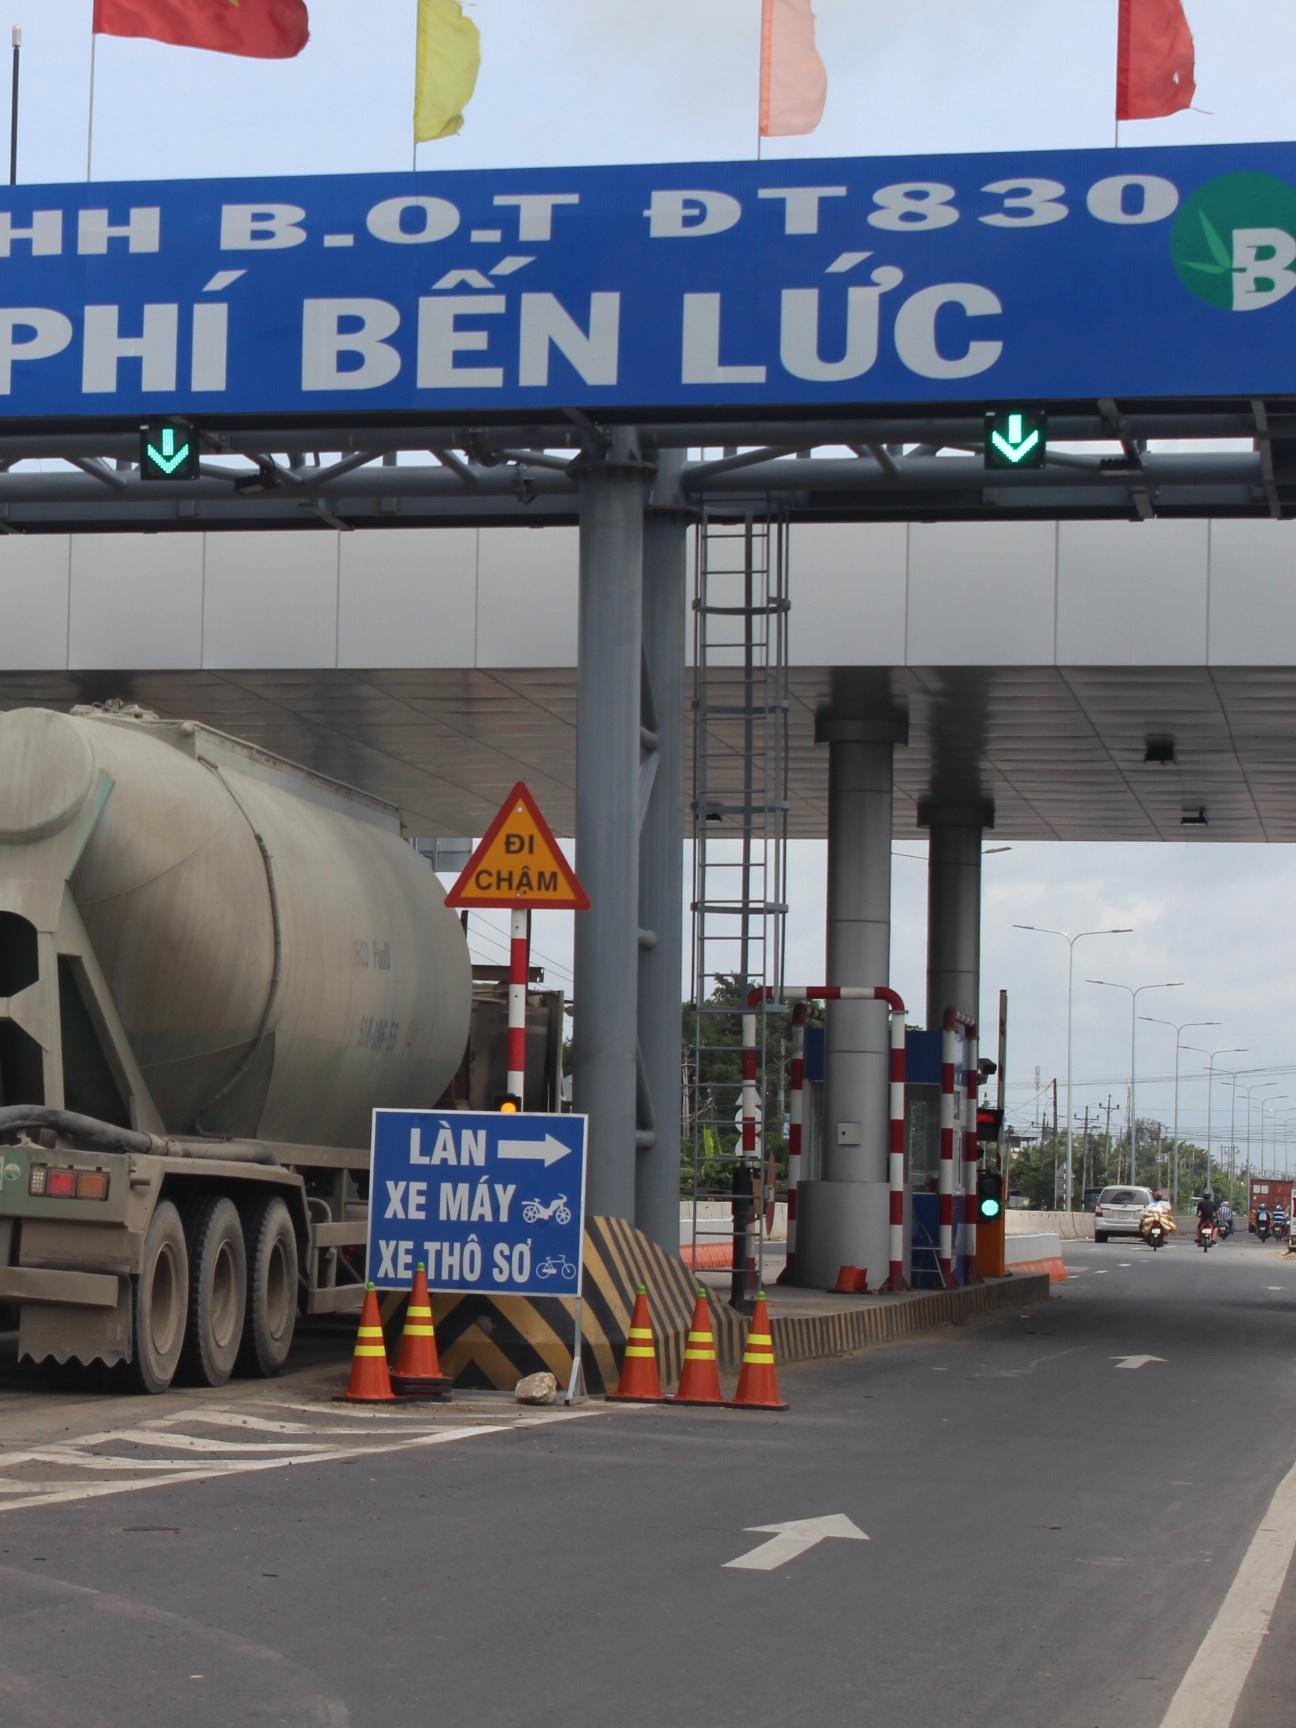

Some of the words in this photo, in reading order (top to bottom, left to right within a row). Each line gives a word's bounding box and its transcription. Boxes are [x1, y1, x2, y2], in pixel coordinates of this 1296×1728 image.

[221, 194, 579, 249] B.O.T
[644, 175, 1178, 237] ĐT830
[302, 257, 619, 390] BẾN
[683, 252, 1002, 383] LỨC
[504, 834, 534, 855] ĐI
[474, 866, 558, 895] CHẬM
[410, 1121, 486, 1166] LÀN
[385, 1181, 427, 1219] XE
[439, 1175, 516, 1222] MÁY
[377, 1240, 413, 1278] XE
[424, 1234, 481, 1282] THÔ
[492, 1238, 532, 1283] SƠ
